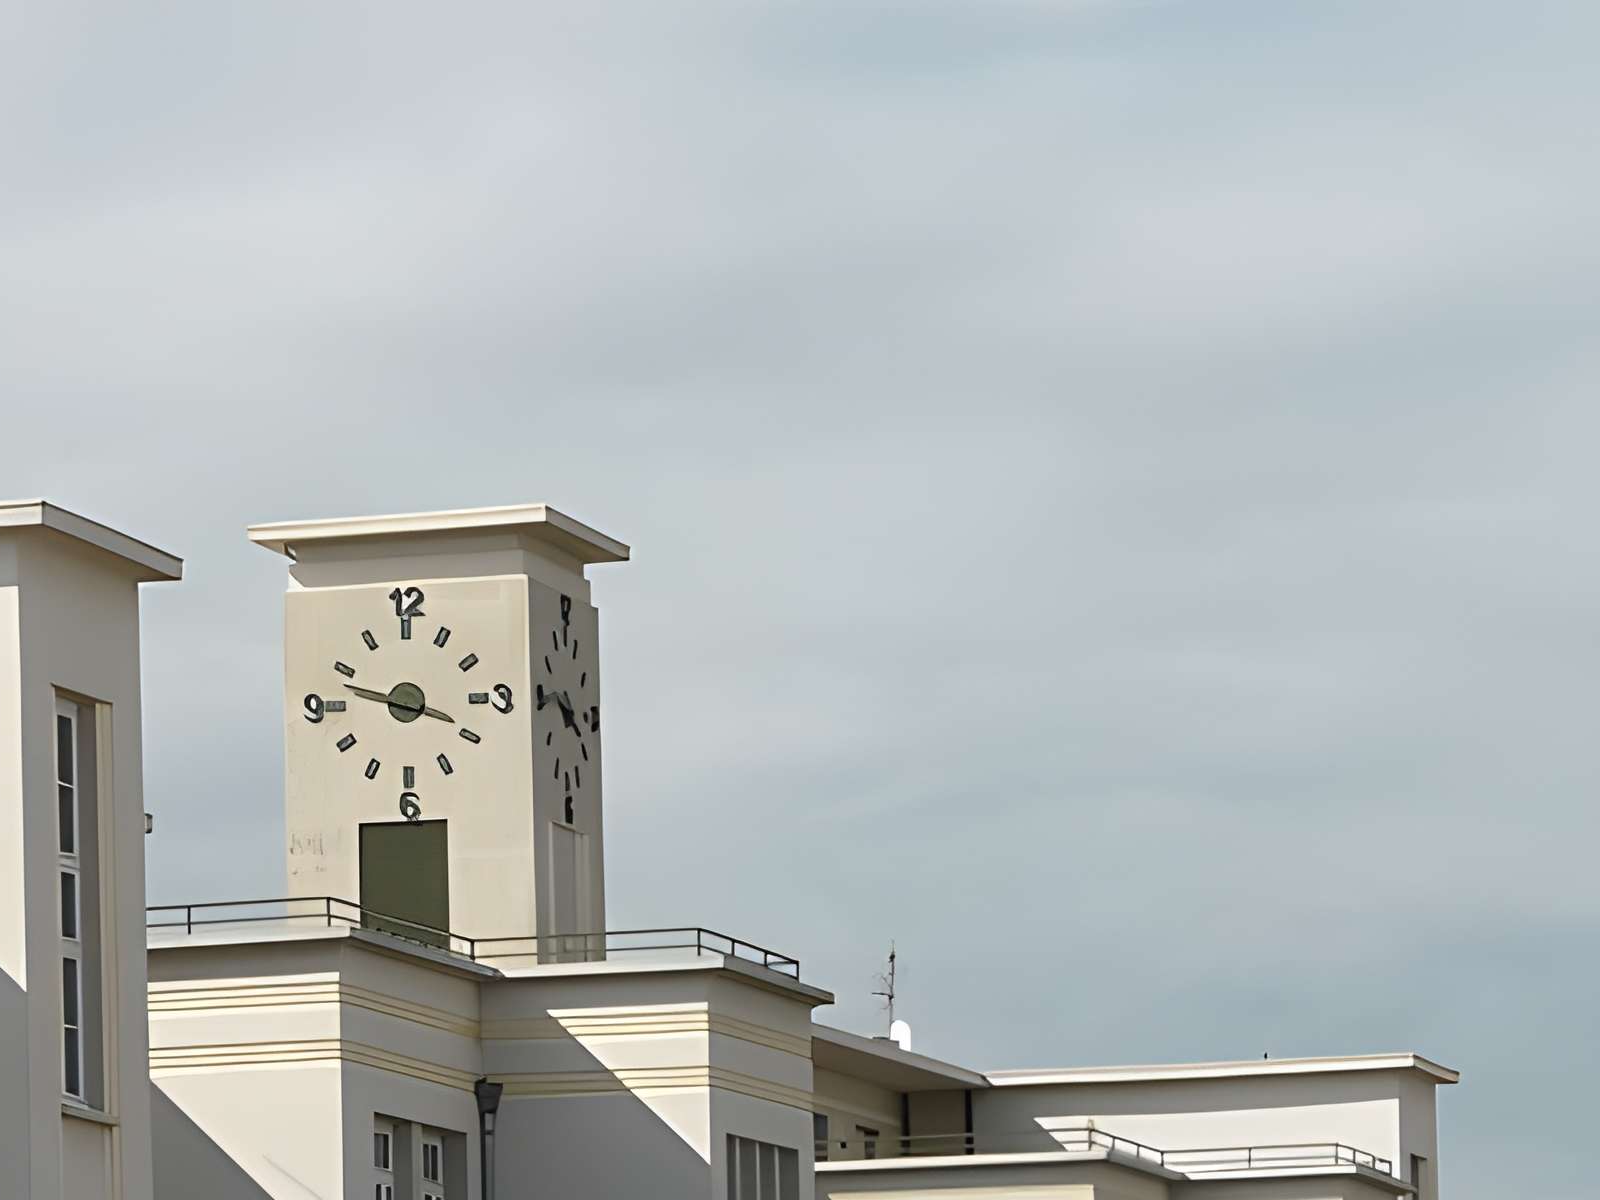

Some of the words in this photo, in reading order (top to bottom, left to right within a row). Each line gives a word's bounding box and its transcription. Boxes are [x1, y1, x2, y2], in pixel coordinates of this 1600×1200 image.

[389, 587, 426, 616] 12
[304, 694, 324, 723] 9
[491, 684, 514, 714] 3
[399, 792, 421, 821] 6
